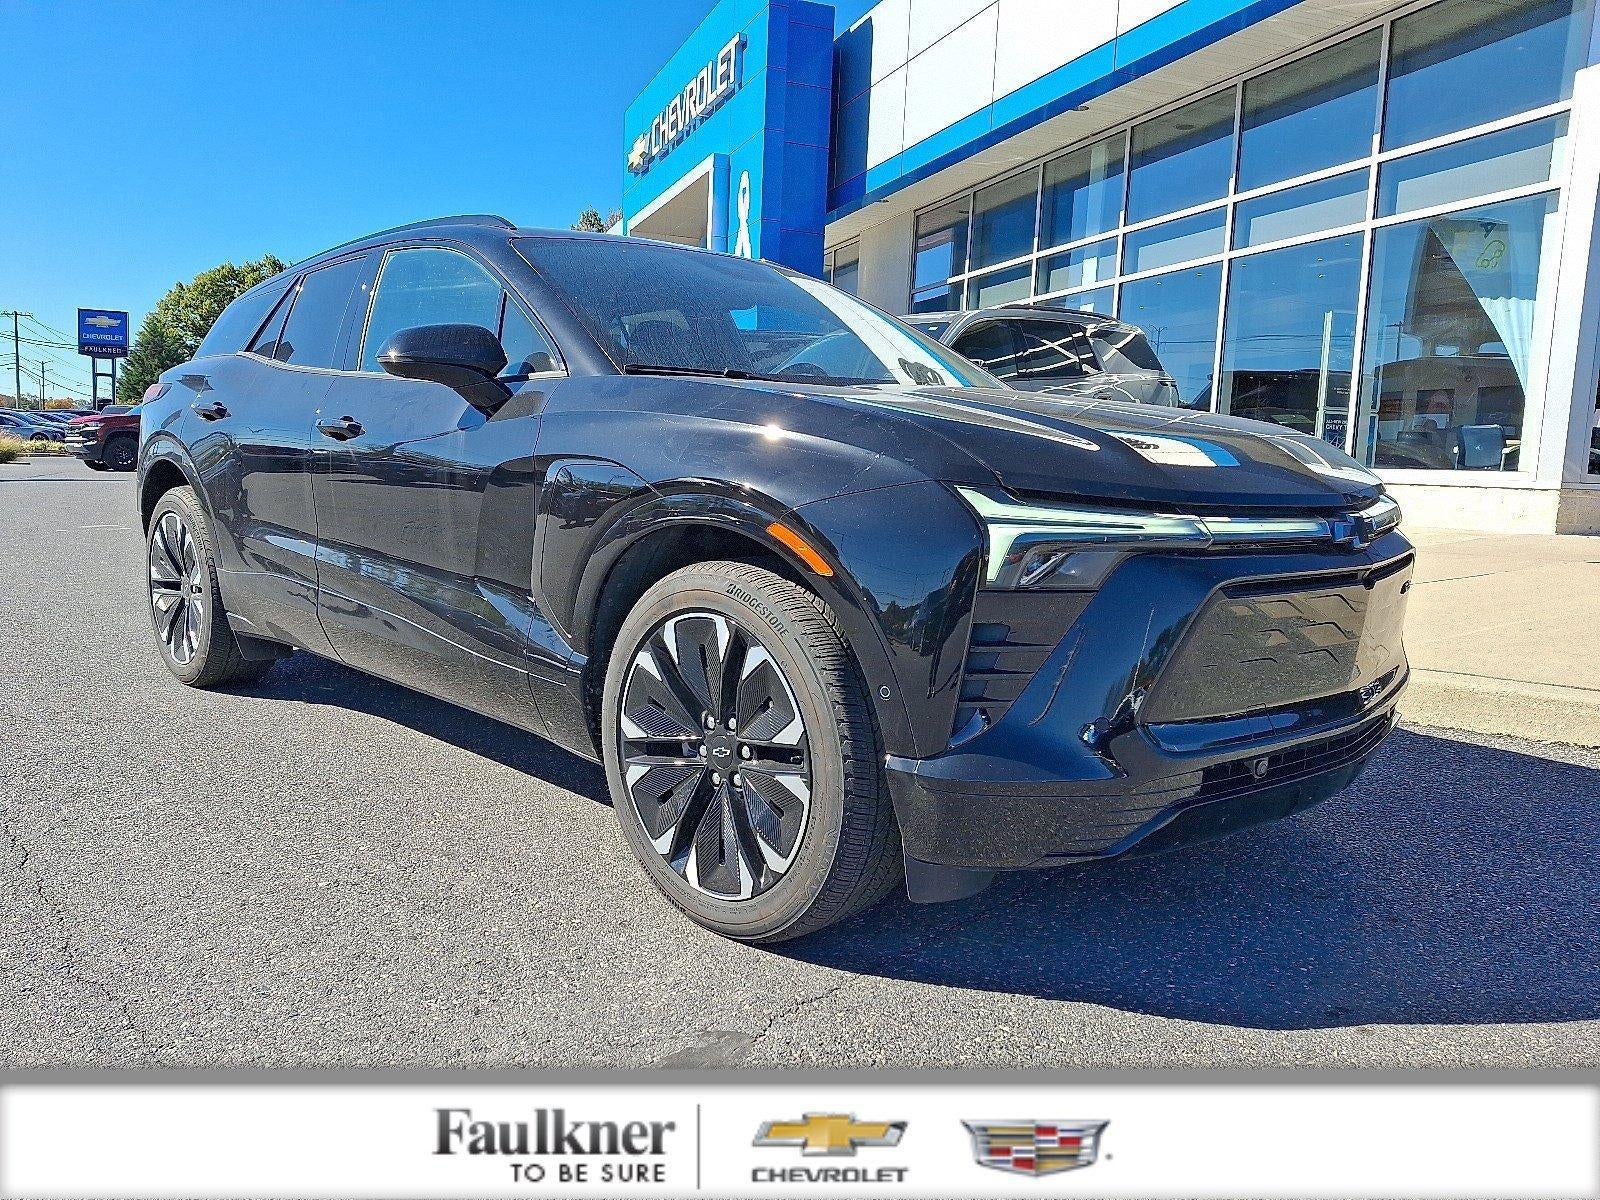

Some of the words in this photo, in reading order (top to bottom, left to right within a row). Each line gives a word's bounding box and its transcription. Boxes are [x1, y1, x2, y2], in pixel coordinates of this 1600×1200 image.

[651, 32, 743, 156] CHEVROLET
[82, 333, 123, 341] CHEVROLET
[726, 583, 789, 638] BRIDGESTONE
